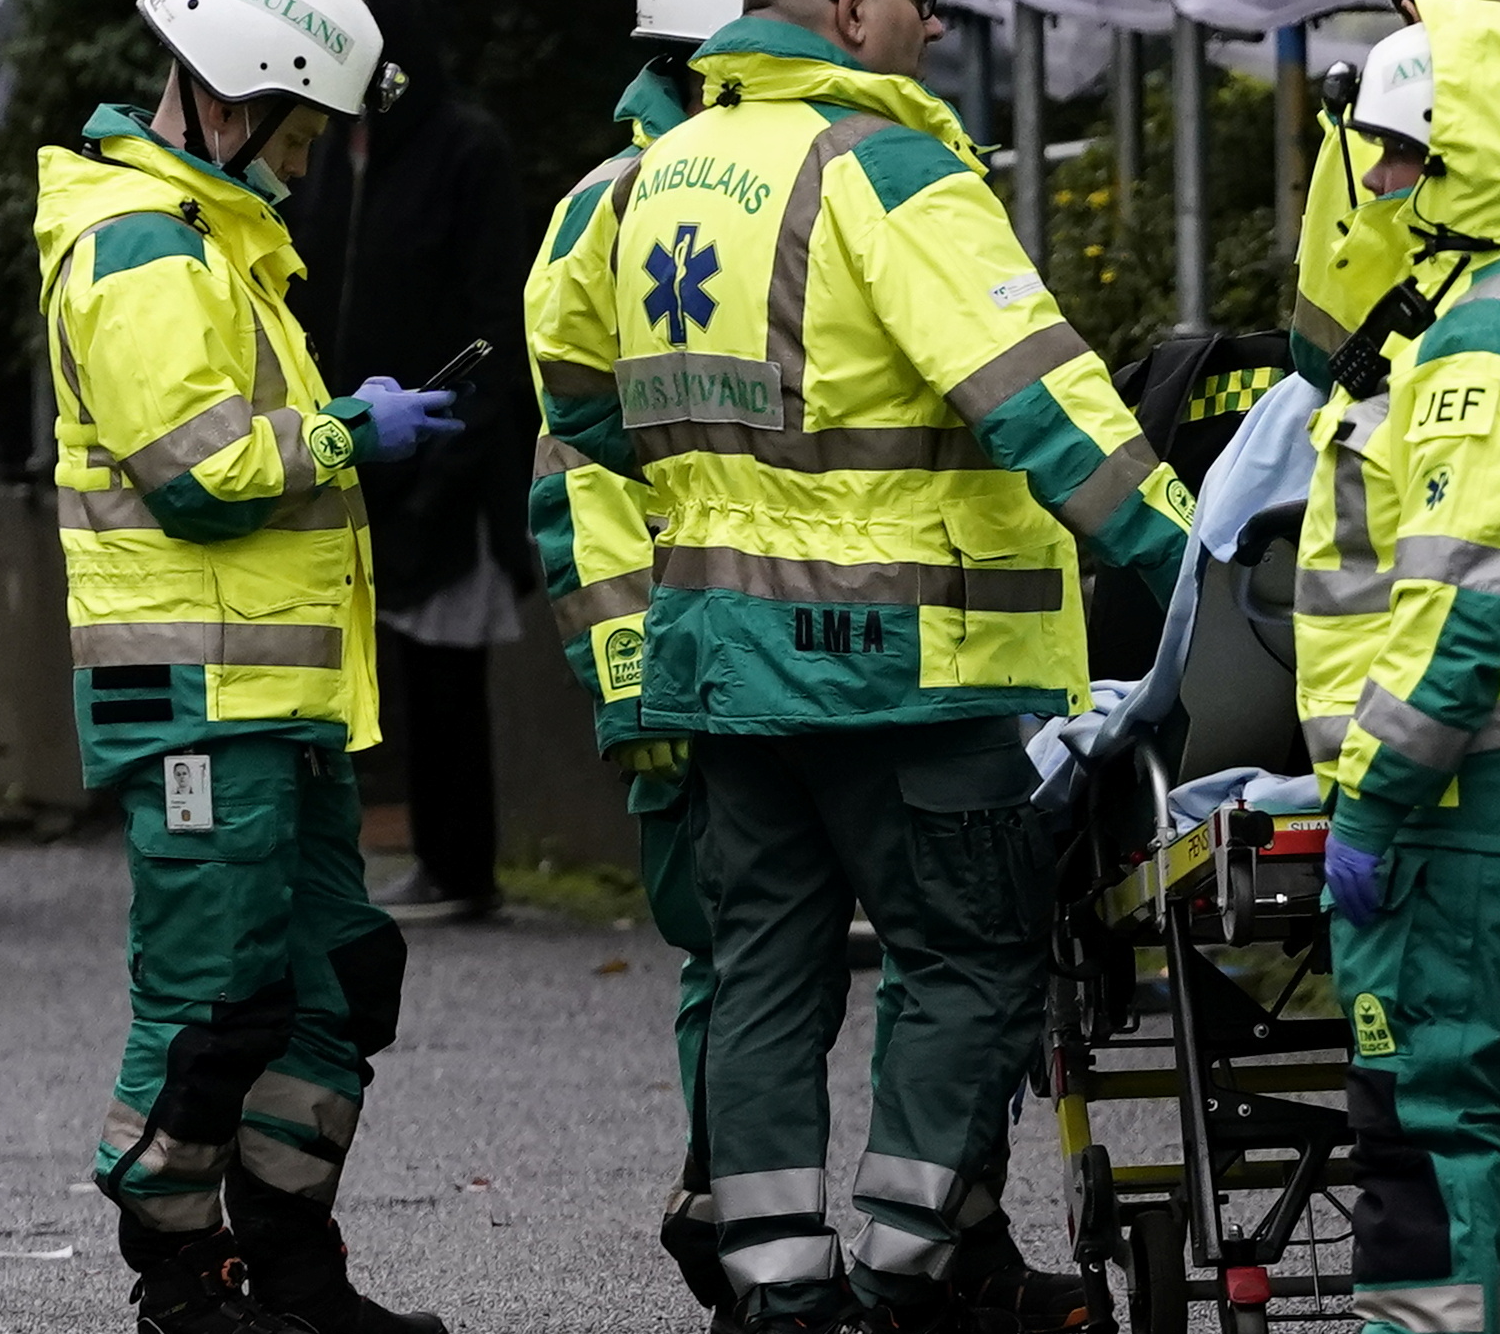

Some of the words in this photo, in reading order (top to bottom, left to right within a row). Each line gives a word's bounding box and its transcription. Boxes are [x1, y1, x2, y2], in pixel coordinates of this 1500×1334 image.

[633, 156, 771, 215] AMBULANS
[1418, 387, 1487, 427] JEF
[615, 671, 642, 684] BLOC
